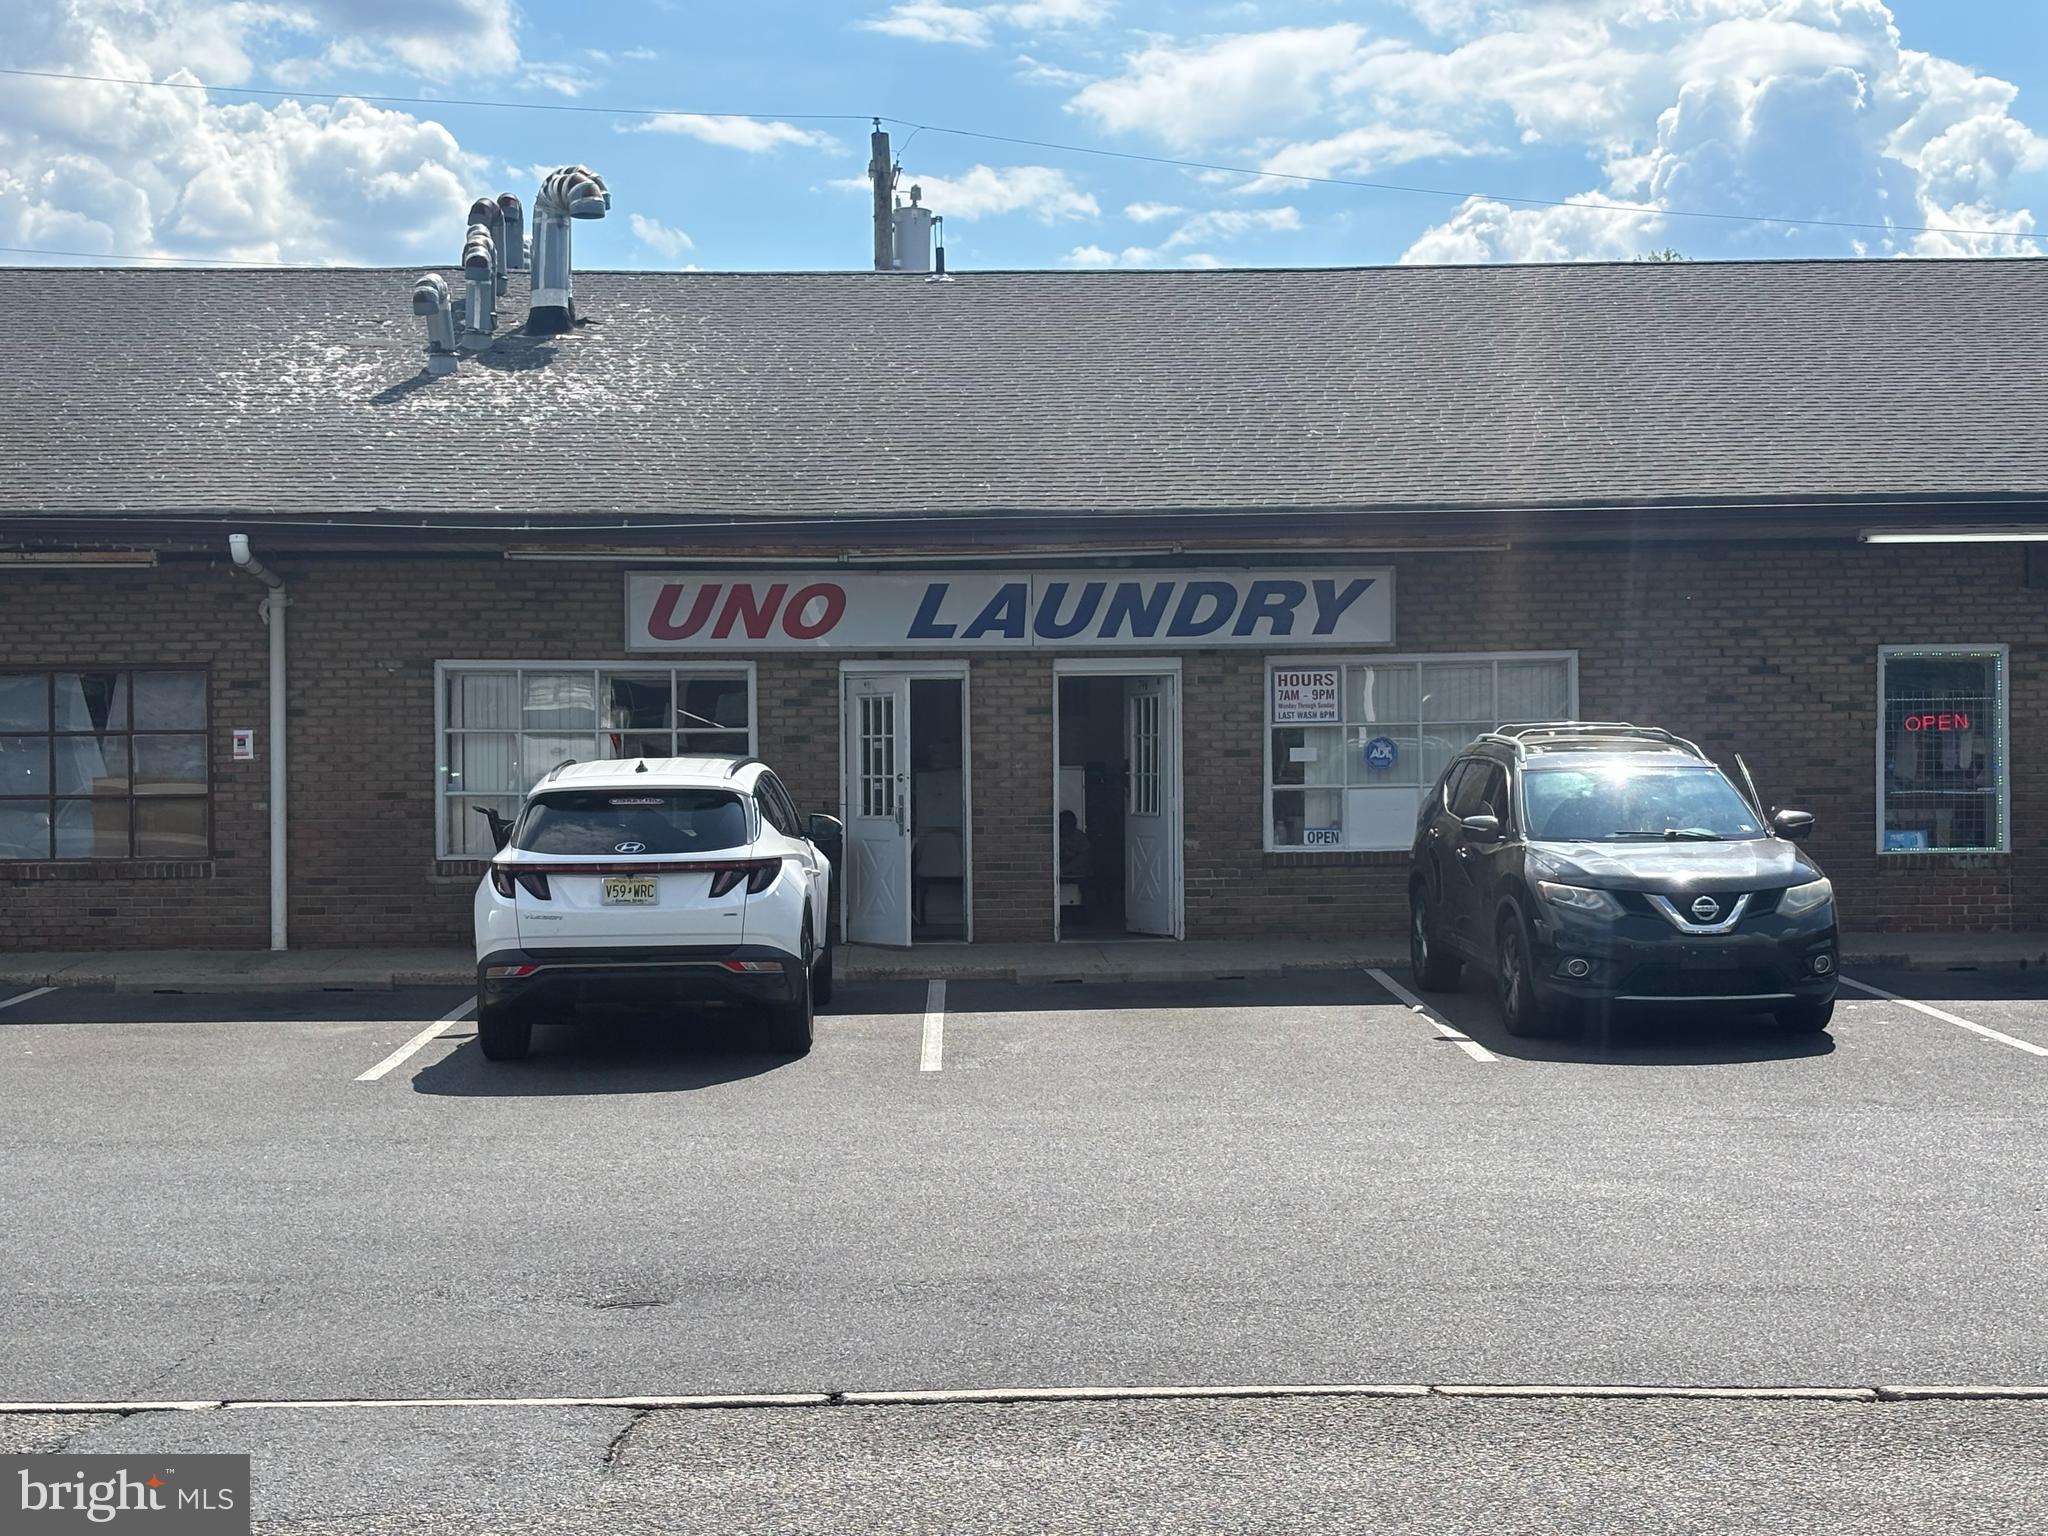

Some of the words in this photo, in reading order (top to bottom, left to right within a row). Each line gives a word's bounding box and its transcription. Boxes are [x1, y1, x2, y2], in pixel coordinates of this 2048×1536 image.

[648, 582, 846, 640] UNO
[906, 578, 1377, 639] LAUNDRY
[1277, 673, 1335, 687] HOURS
[1278, 689, 1300, 701] 7AM
[1311, 689, 1335, 701] 9PM
[1278, 711, 1296, 719] LAST
[1297, 711, 1318, 719] WASH
[1904, 713, 1969, 732] OPEN
[1307, 831, 1339, 844] OPEN
[606, 884, 626, 898] V59
[633, 884, 655, 898] WRC
